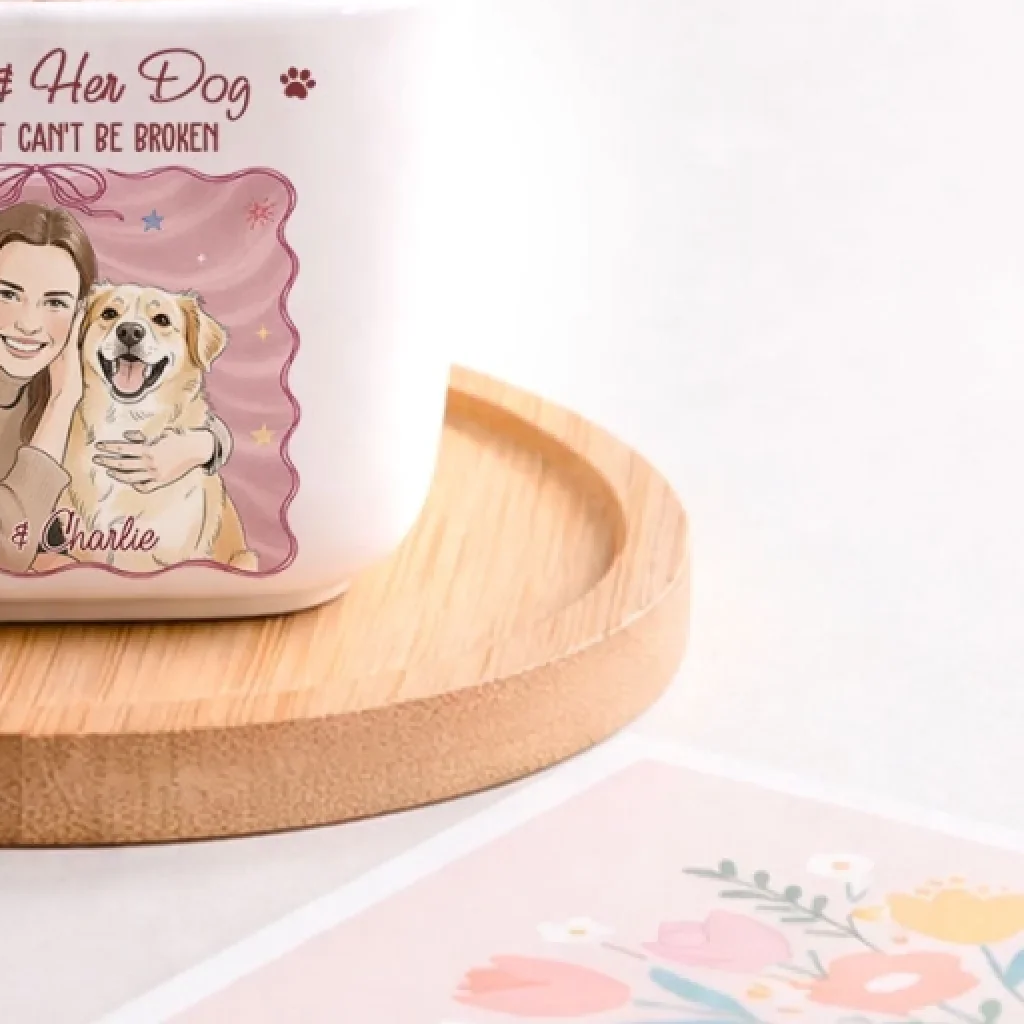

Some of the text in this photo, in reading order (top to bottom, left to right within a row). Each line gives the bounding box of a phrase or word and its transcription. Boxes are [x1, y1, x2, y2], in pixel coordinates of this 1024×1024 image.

[30, 47, 126, 104] Her
[137, 47, 251, 121] Dog
[18, 122, 83, 153] CAN'T
[95, 122, 123, 153] BE
[134, 122, 219, 153] BROKEN
[12, 519, 29, 550] &
[42, 507, 160, 552] Charlie
